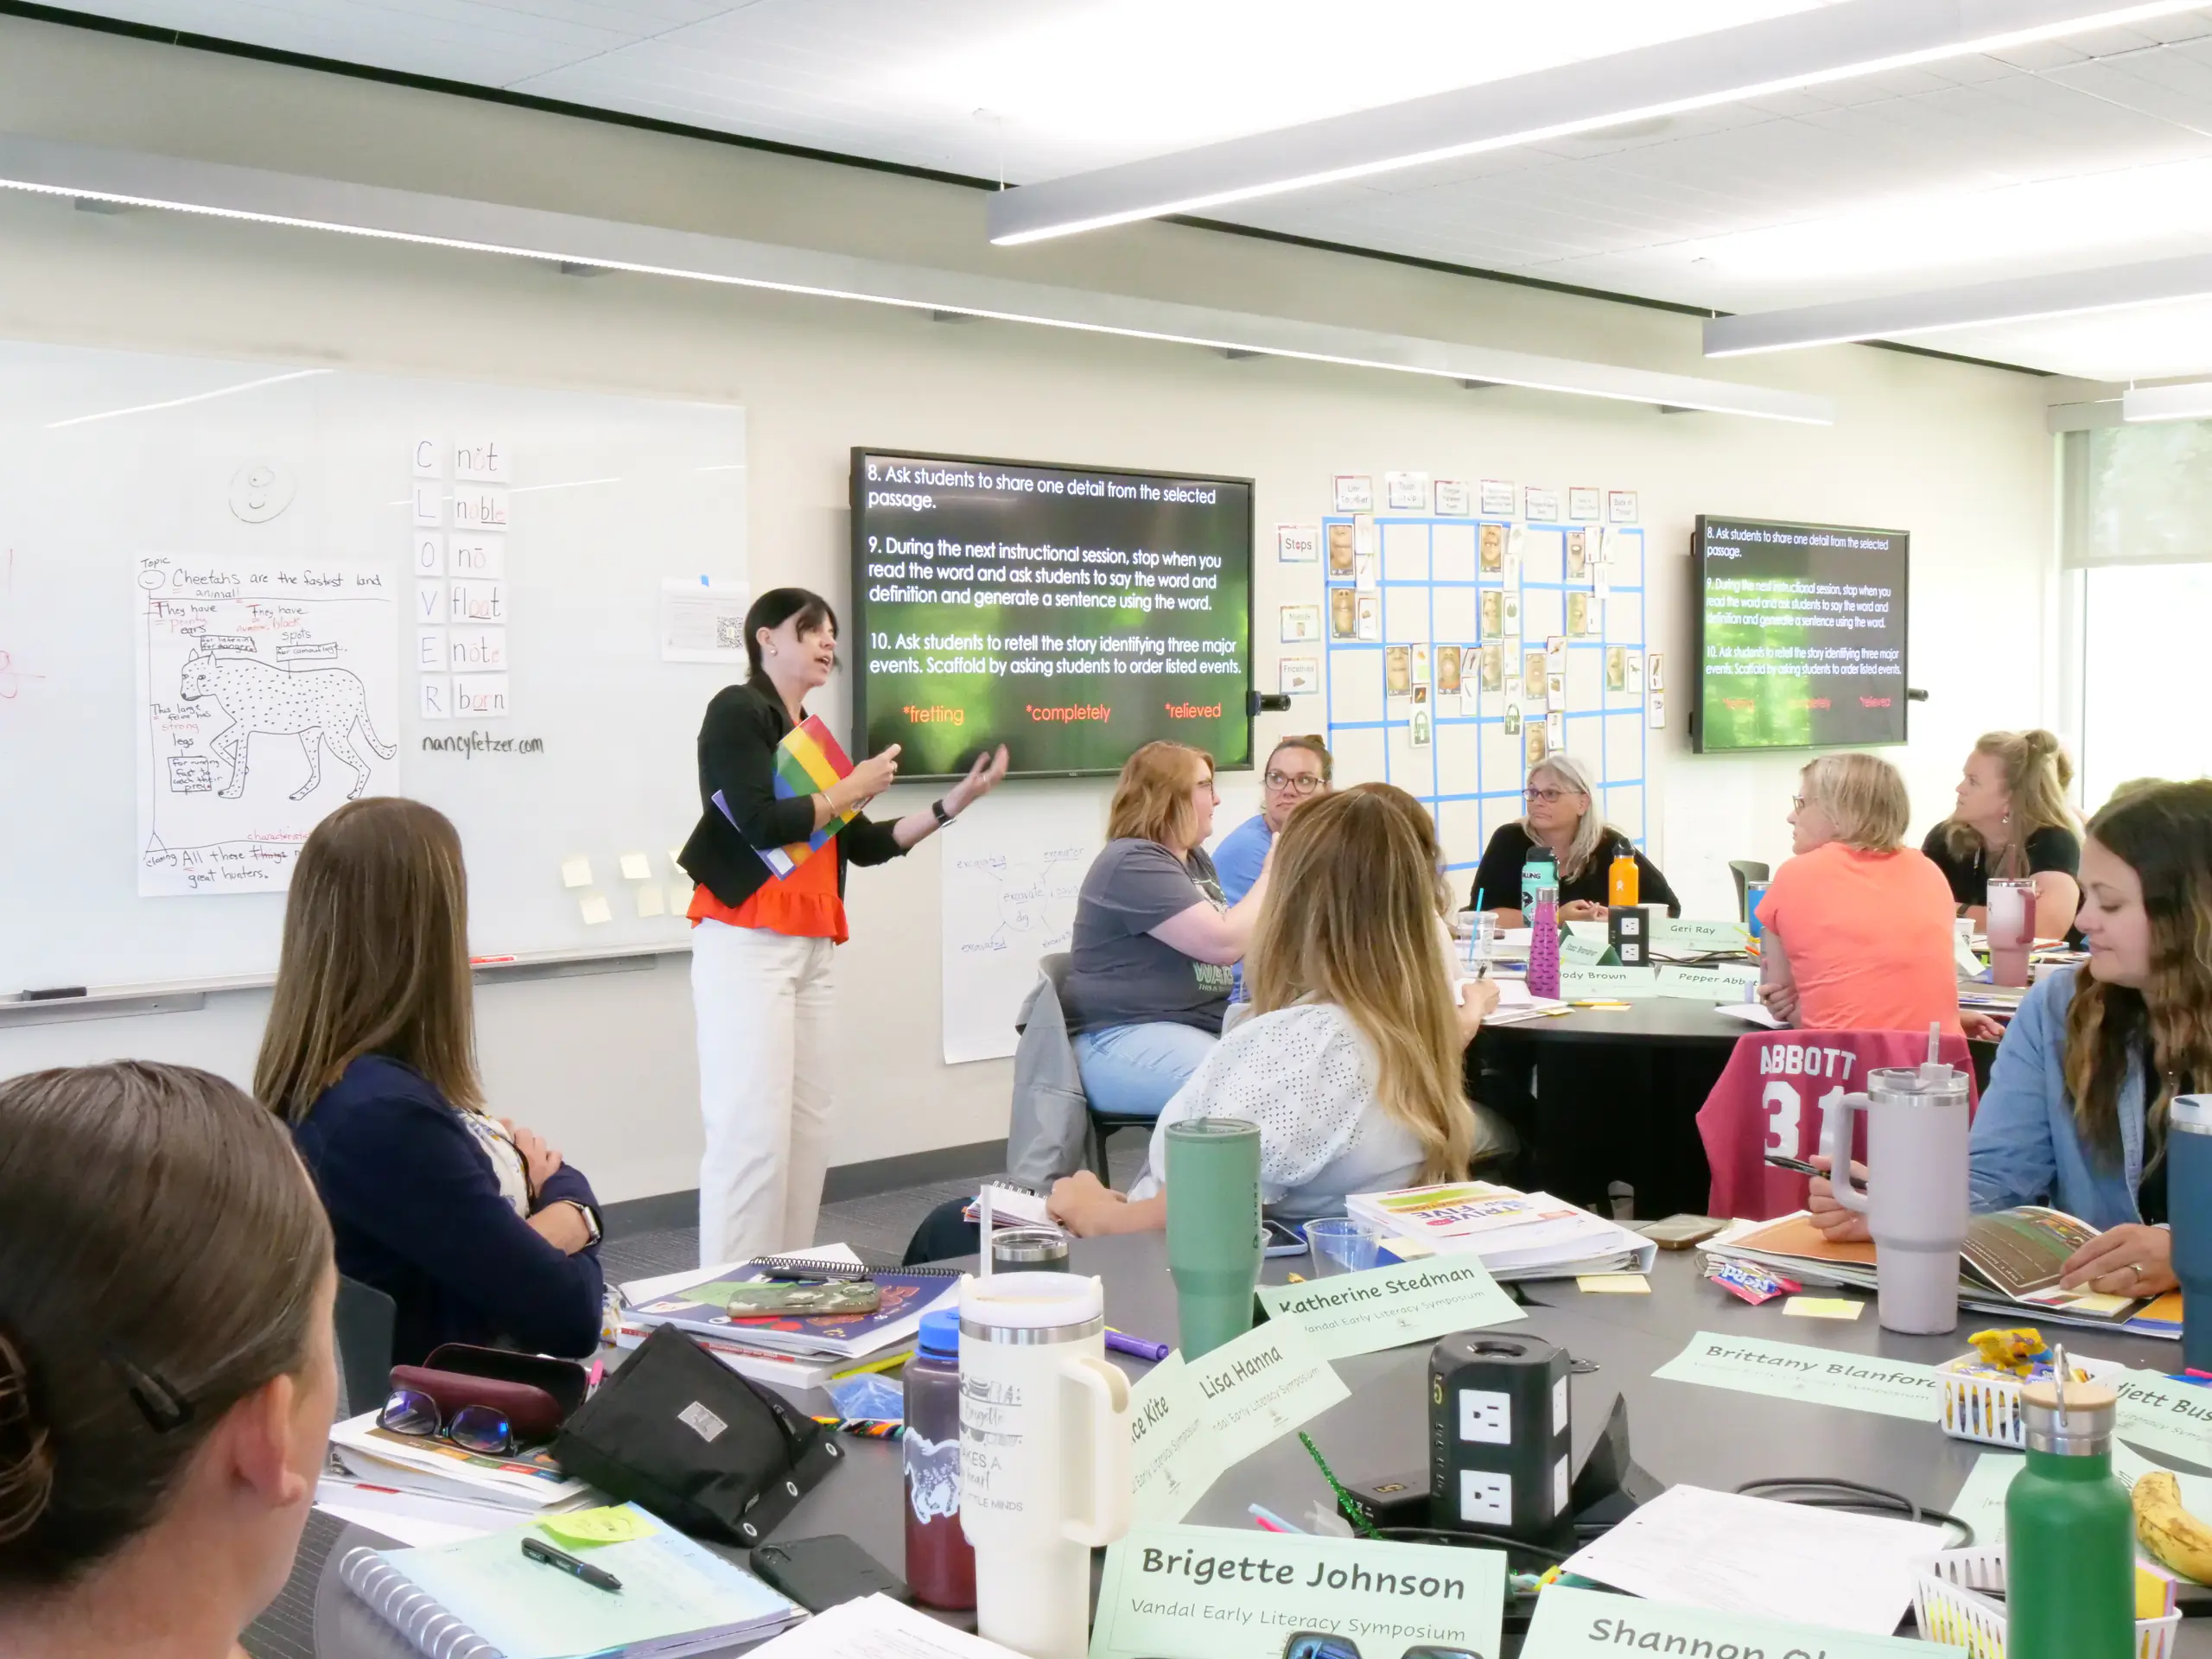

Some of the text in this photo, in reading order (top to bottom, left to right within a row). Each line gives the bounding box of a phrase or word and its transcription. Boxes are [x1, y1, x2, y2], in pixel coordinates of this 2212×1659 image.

[417, 441, 432, 467] C
[868, 464, 1215, 504] 8. Ask students to share one detail from the selected
[417, 489, 436, 518] L
[457, 495, 506, 522] noble
[867, 491, 936, 511] passage.
[1707, 526, 1888, 550] 8. Ask students to share one detail from the selected
[141, 556, 170, 569] Topic
[422, 542, 435, 568] O
[868, 535, 1221, 570] 9. During the next instructional session, stop when you
[1707, 545, 1741, 559] passage.
[173, 569, 382, 587] Cheetahs are the fastest land
[868, 562, 1217, 588] read the word and ask students to say the word and
[151, 601, 218, 618] They have
[421, 591, 438, 615] V
[453, 587, 501, 617] float
[868, 584, 1211, 612] definition and generate a sentence using the word.
[246, 604, 308, 617] They have
[181, 626, 207, 636] ears
[283, 629, 312, 645] spots
[423, 637, 438, 664] E
[870, 632, 1236, 656] 10. Ask students to retell the story identifying three major
[869, 656, 1241, 677] events. Scaffold by asking students to order listed events.
[427, 685, 442, 712] R
[460, 683, 505, 710] born
[150, 703, 200, 715] This large
[168, 713, 190, 722] feline
[162, 723, 199, 734] strong
[173, 732, 194, 748] legs
[423, 730, 544, 760] nancyfetzer.com
[173, 758, 188, 766] for
[176, 768, 195, 777] fast
[182, 850, 203, 866] All
[210, 846, 245, 862] these
[188, 866, 269, 889] great hunters.
[1016, 911, 1029, 928] dig
[1671, 925, 1715, 936] Geri Ray
[1559, 970, 1626, 980] ody Brown
[1679, 973, 1719, 983] Pepper
[1760, 1044, 1857, 1080] ABBOTT
[1762, 1081, 1844, 1166] 31
[1279, 1267, 1475, 1314] Katherine Stedman
[1305, 1292, 1485, 1334] andal Early Literacy Symposium
[1706, 1345, 1818, 1372] Brittany
[1199, 1345, 1283, 1399] Lisa Hanna
[1143, 1395, 1169, 1428] Kite
[2171, 1399, 2212, 1422] Bus
[991, 1498, 1023, 1512] MINDS
[1142, 1548, 1465, 1600] Brigette Johnson
[1131, 1599, 1466, 1643] Vandal Early Literacy Symposium
[1588, 1618, 1765, 1659] Shannon
